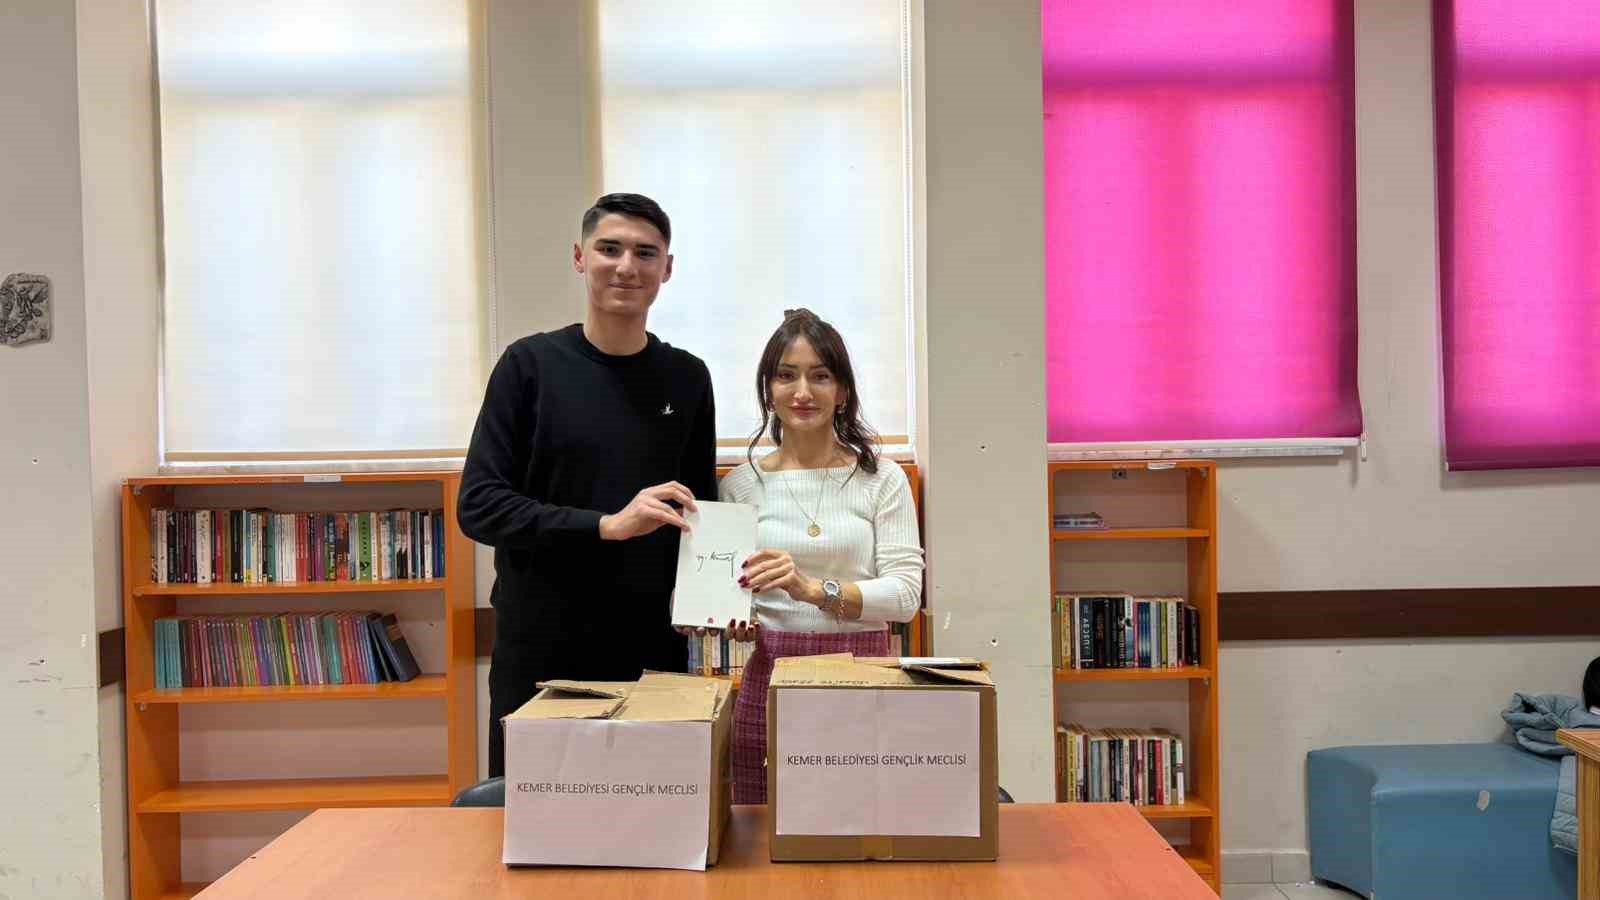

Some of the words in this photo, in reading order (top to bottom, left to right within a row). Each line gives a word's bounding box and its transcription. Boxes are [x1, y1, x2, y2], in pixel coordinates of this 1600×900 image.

[787, 755, 822, 766] KEMER
[825, 753, 879, 766] BELEDİYESİ
[881, 754, 924, 767] GENÇLİK
[927, 753, 967, 766] MECLİSİ
[517, 782, 552, 793] KEMER
[555, 781, 610, 795] BELEDİYESİ
[612, 781, 656, 797] GENÇLİK
[658, 783, 698, 795] MECLİSİ
